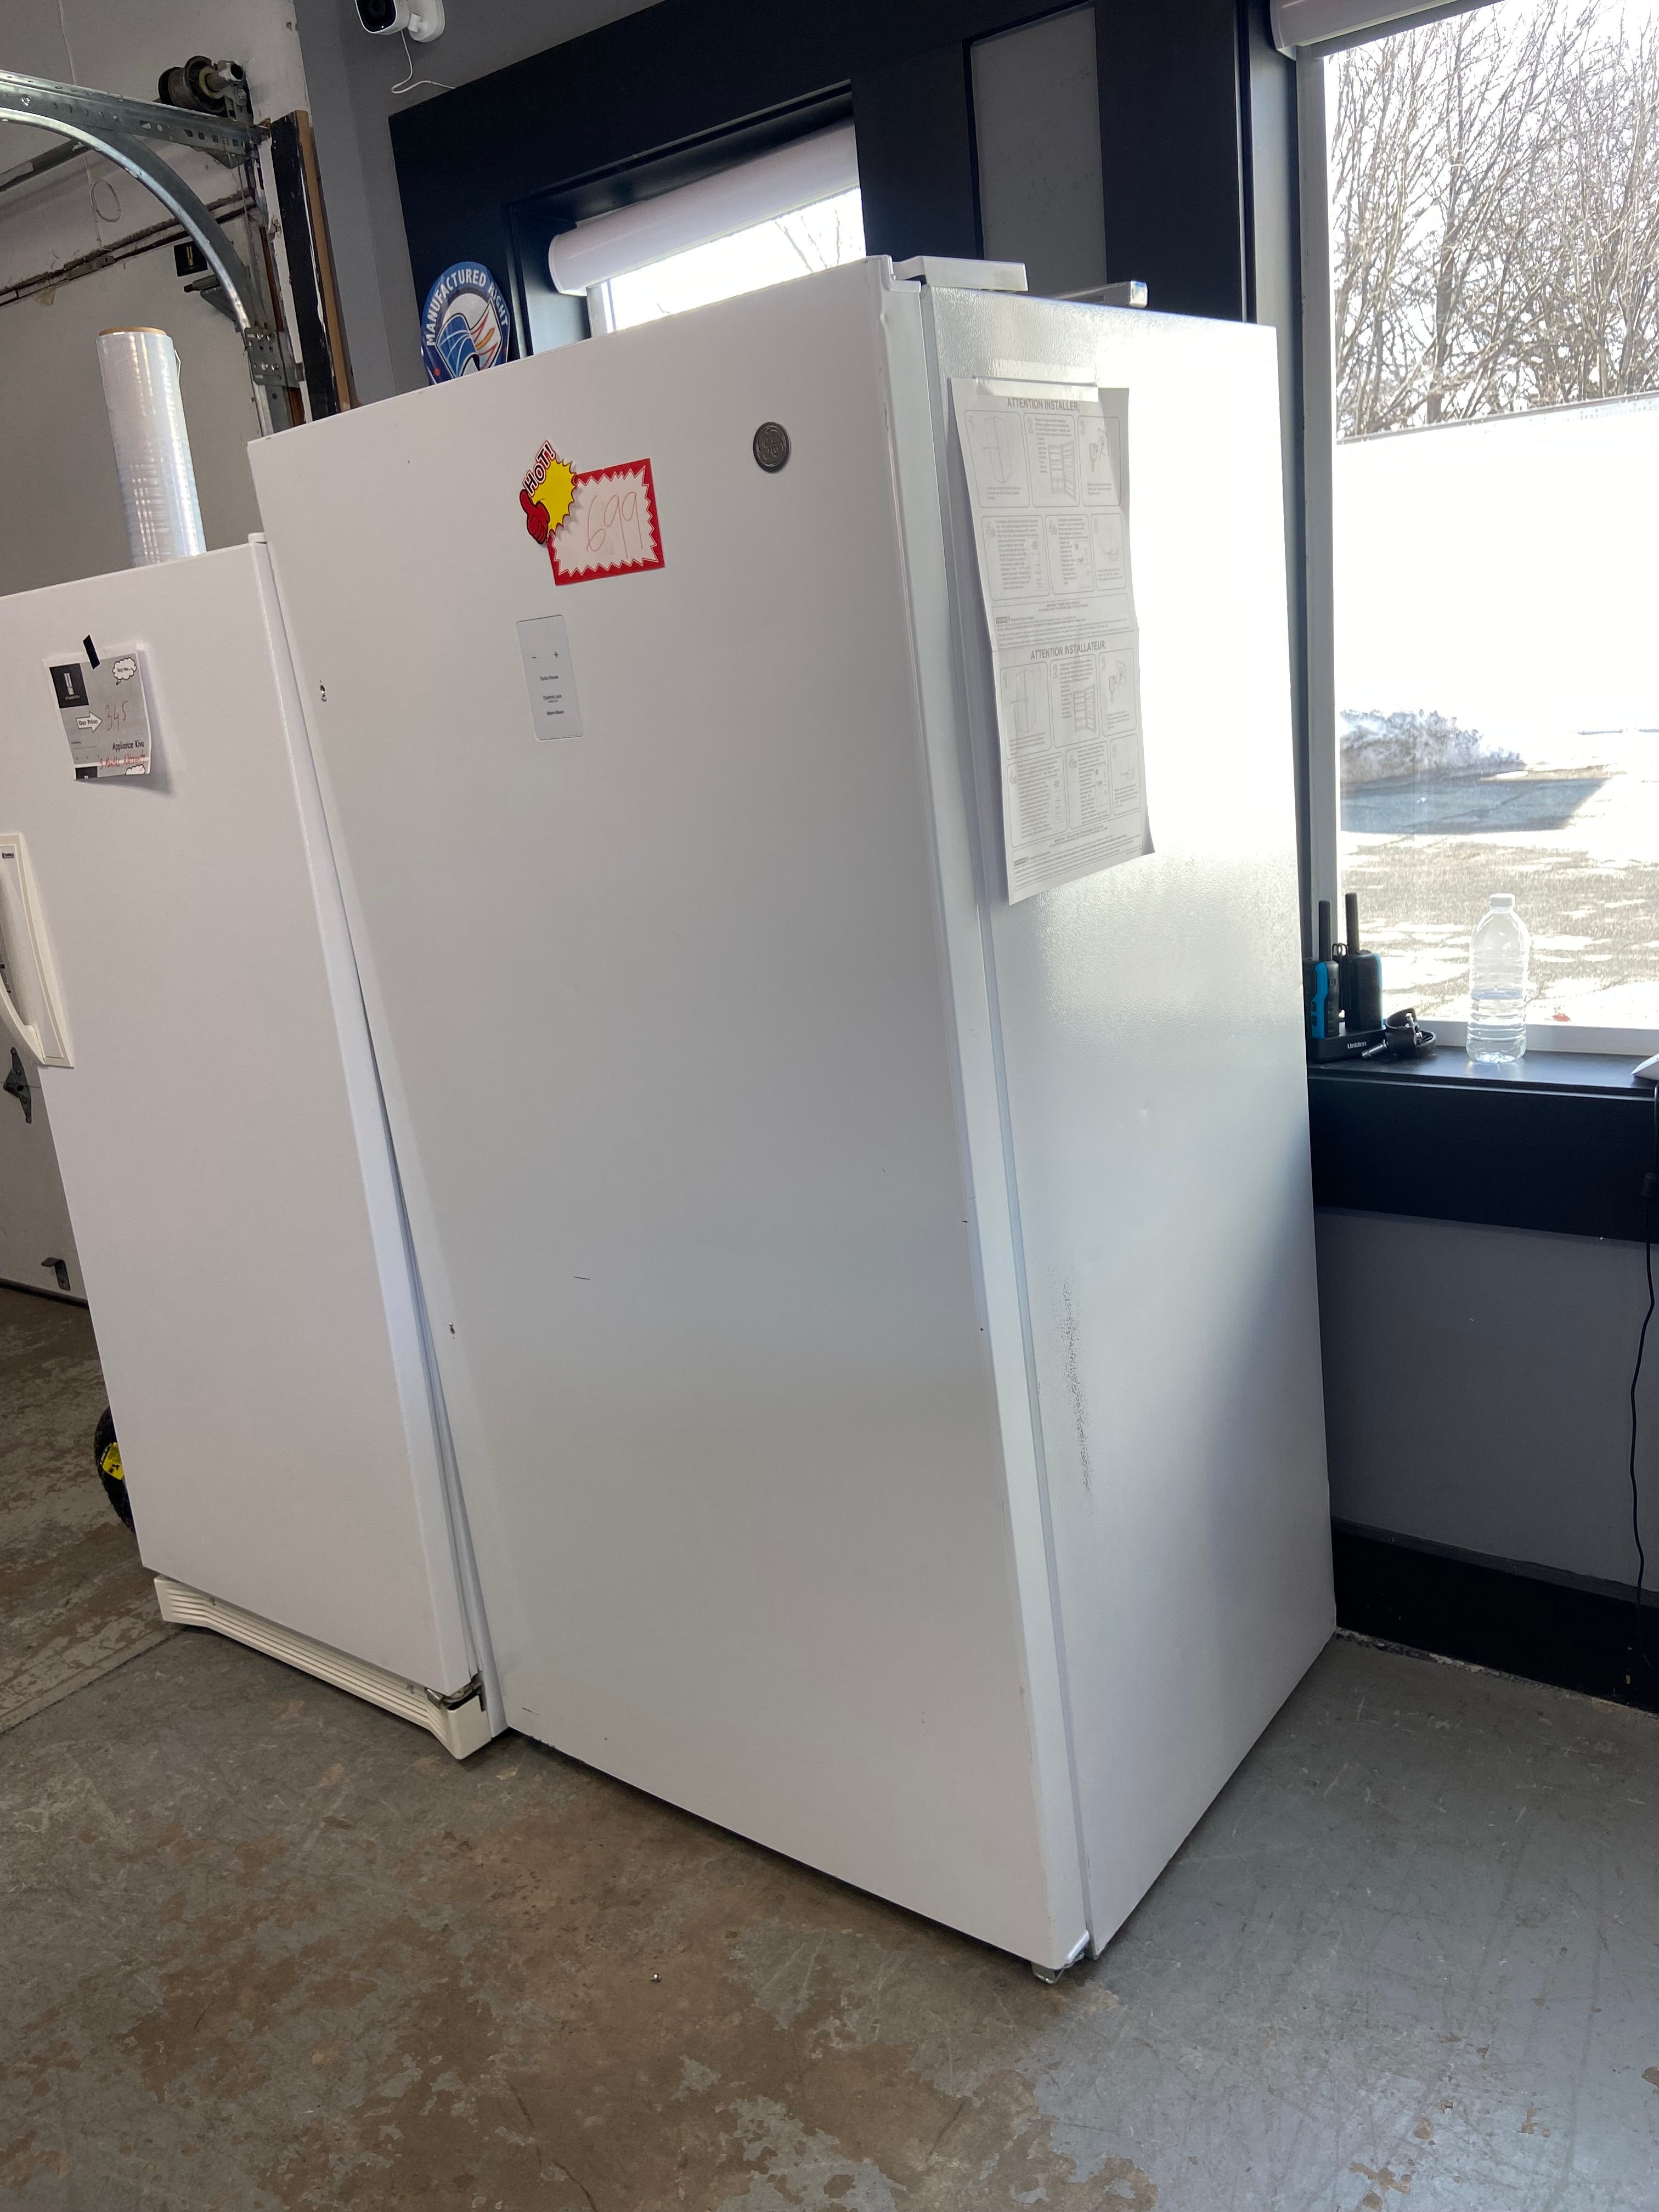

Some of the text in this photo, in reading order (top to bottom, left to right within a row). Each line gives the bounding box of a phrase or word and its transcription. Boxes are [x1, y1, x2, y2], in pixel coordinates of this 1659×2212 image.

[426, 269, 508, 346] MANUFACTURED RIGHT
[1007, 398, 1043, 409] ATTENTION
[1027, 417, 1034, 433] 2
[523, 443, 555, 495] HOT!
[586, 492, 643, 558] 699
[1031, 646, 1063, 660] ATTENTION
[1053, 664, 1058, 679] 2
